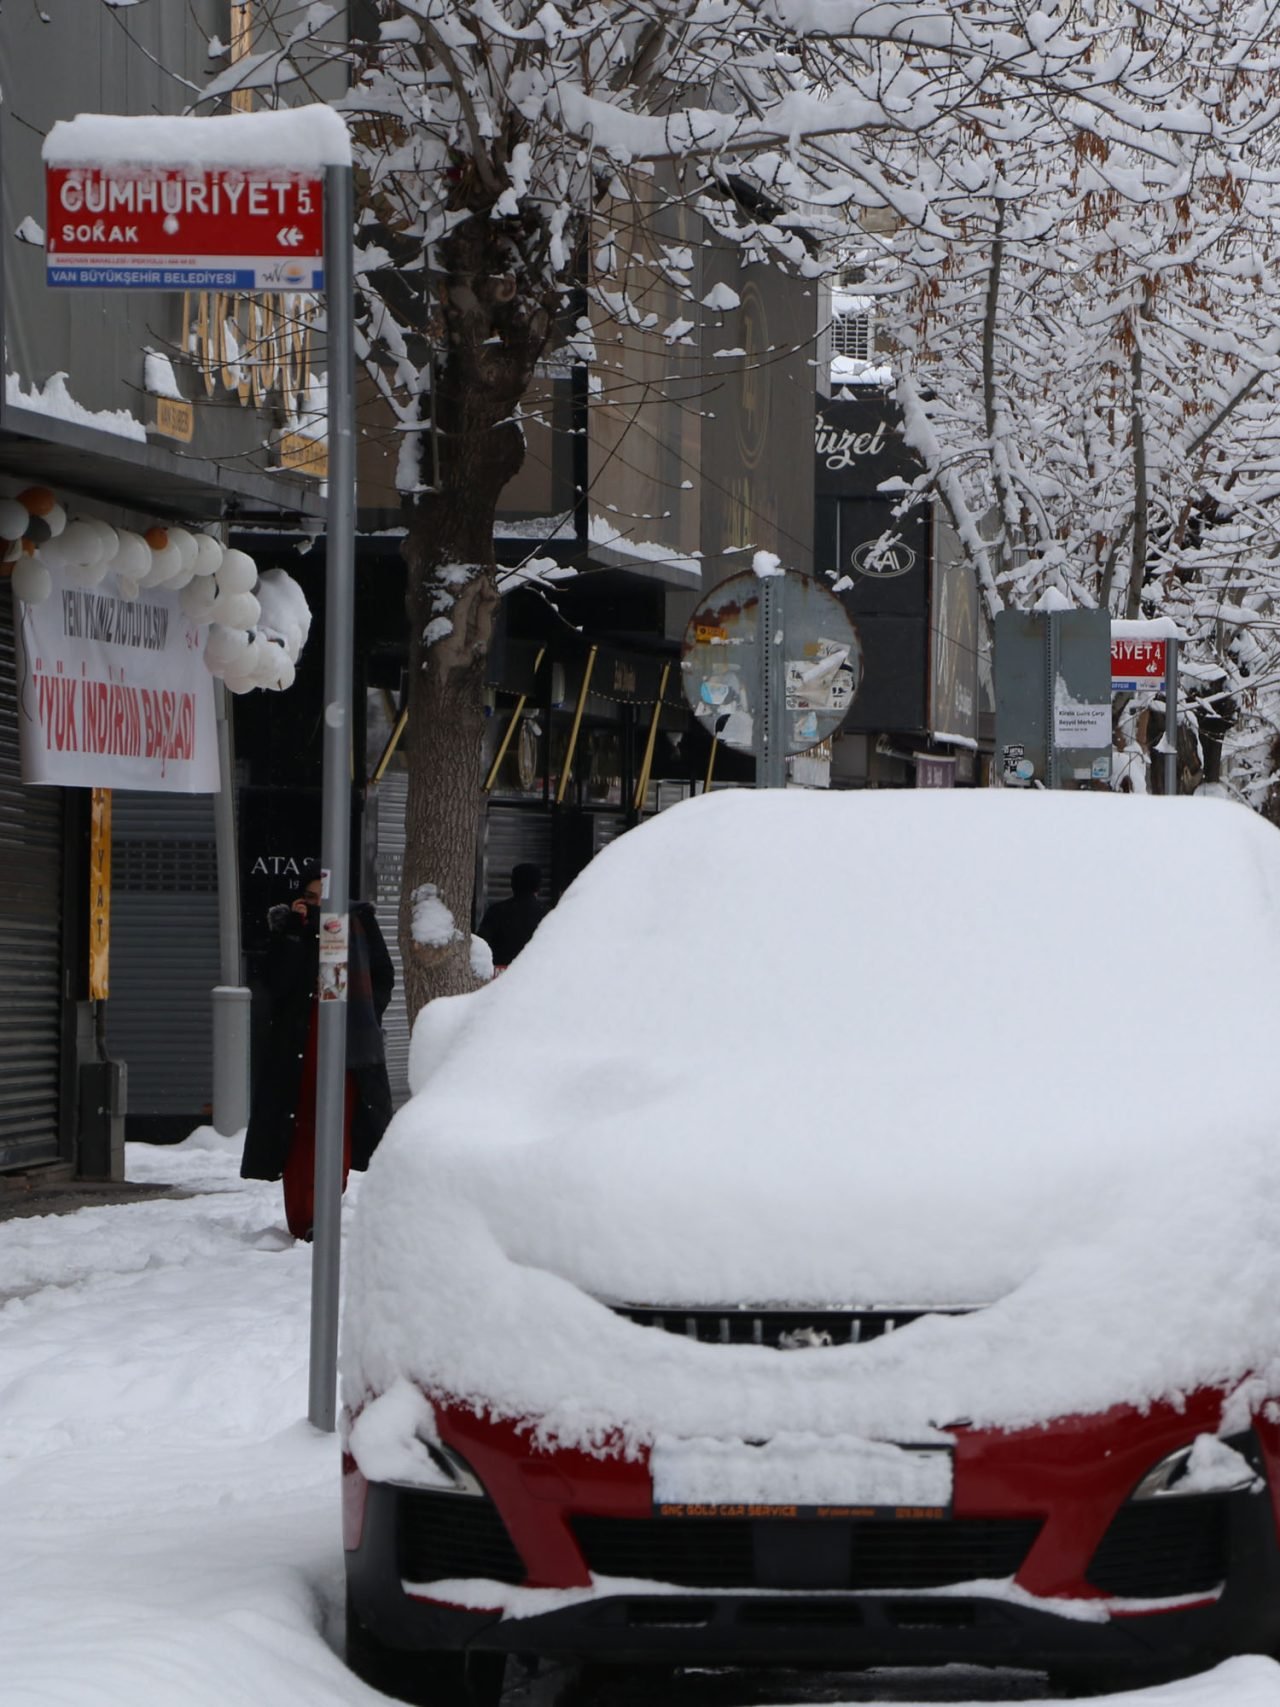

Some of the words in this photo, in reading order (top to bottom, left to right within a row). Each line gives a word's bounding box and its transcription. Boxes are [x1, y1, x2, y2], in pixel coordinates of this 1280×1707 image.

[60, 179, 291, 215] CUMHURİYET
[62, 225, 138, 243] SOKAK
[51, 271, 77, 281] VAN
[80, 269, 160, 285] BÜYÜKŞEHİR
[164, 270, 236, 285] BELEDİYESİ
[82, 660, 140, 757] İNDİRİM
[141, 687, 196, 778] BAŞLADI
[719, 1505, 745, 1517] CAR
[747, 1505, 798, 1517] SERVICE
